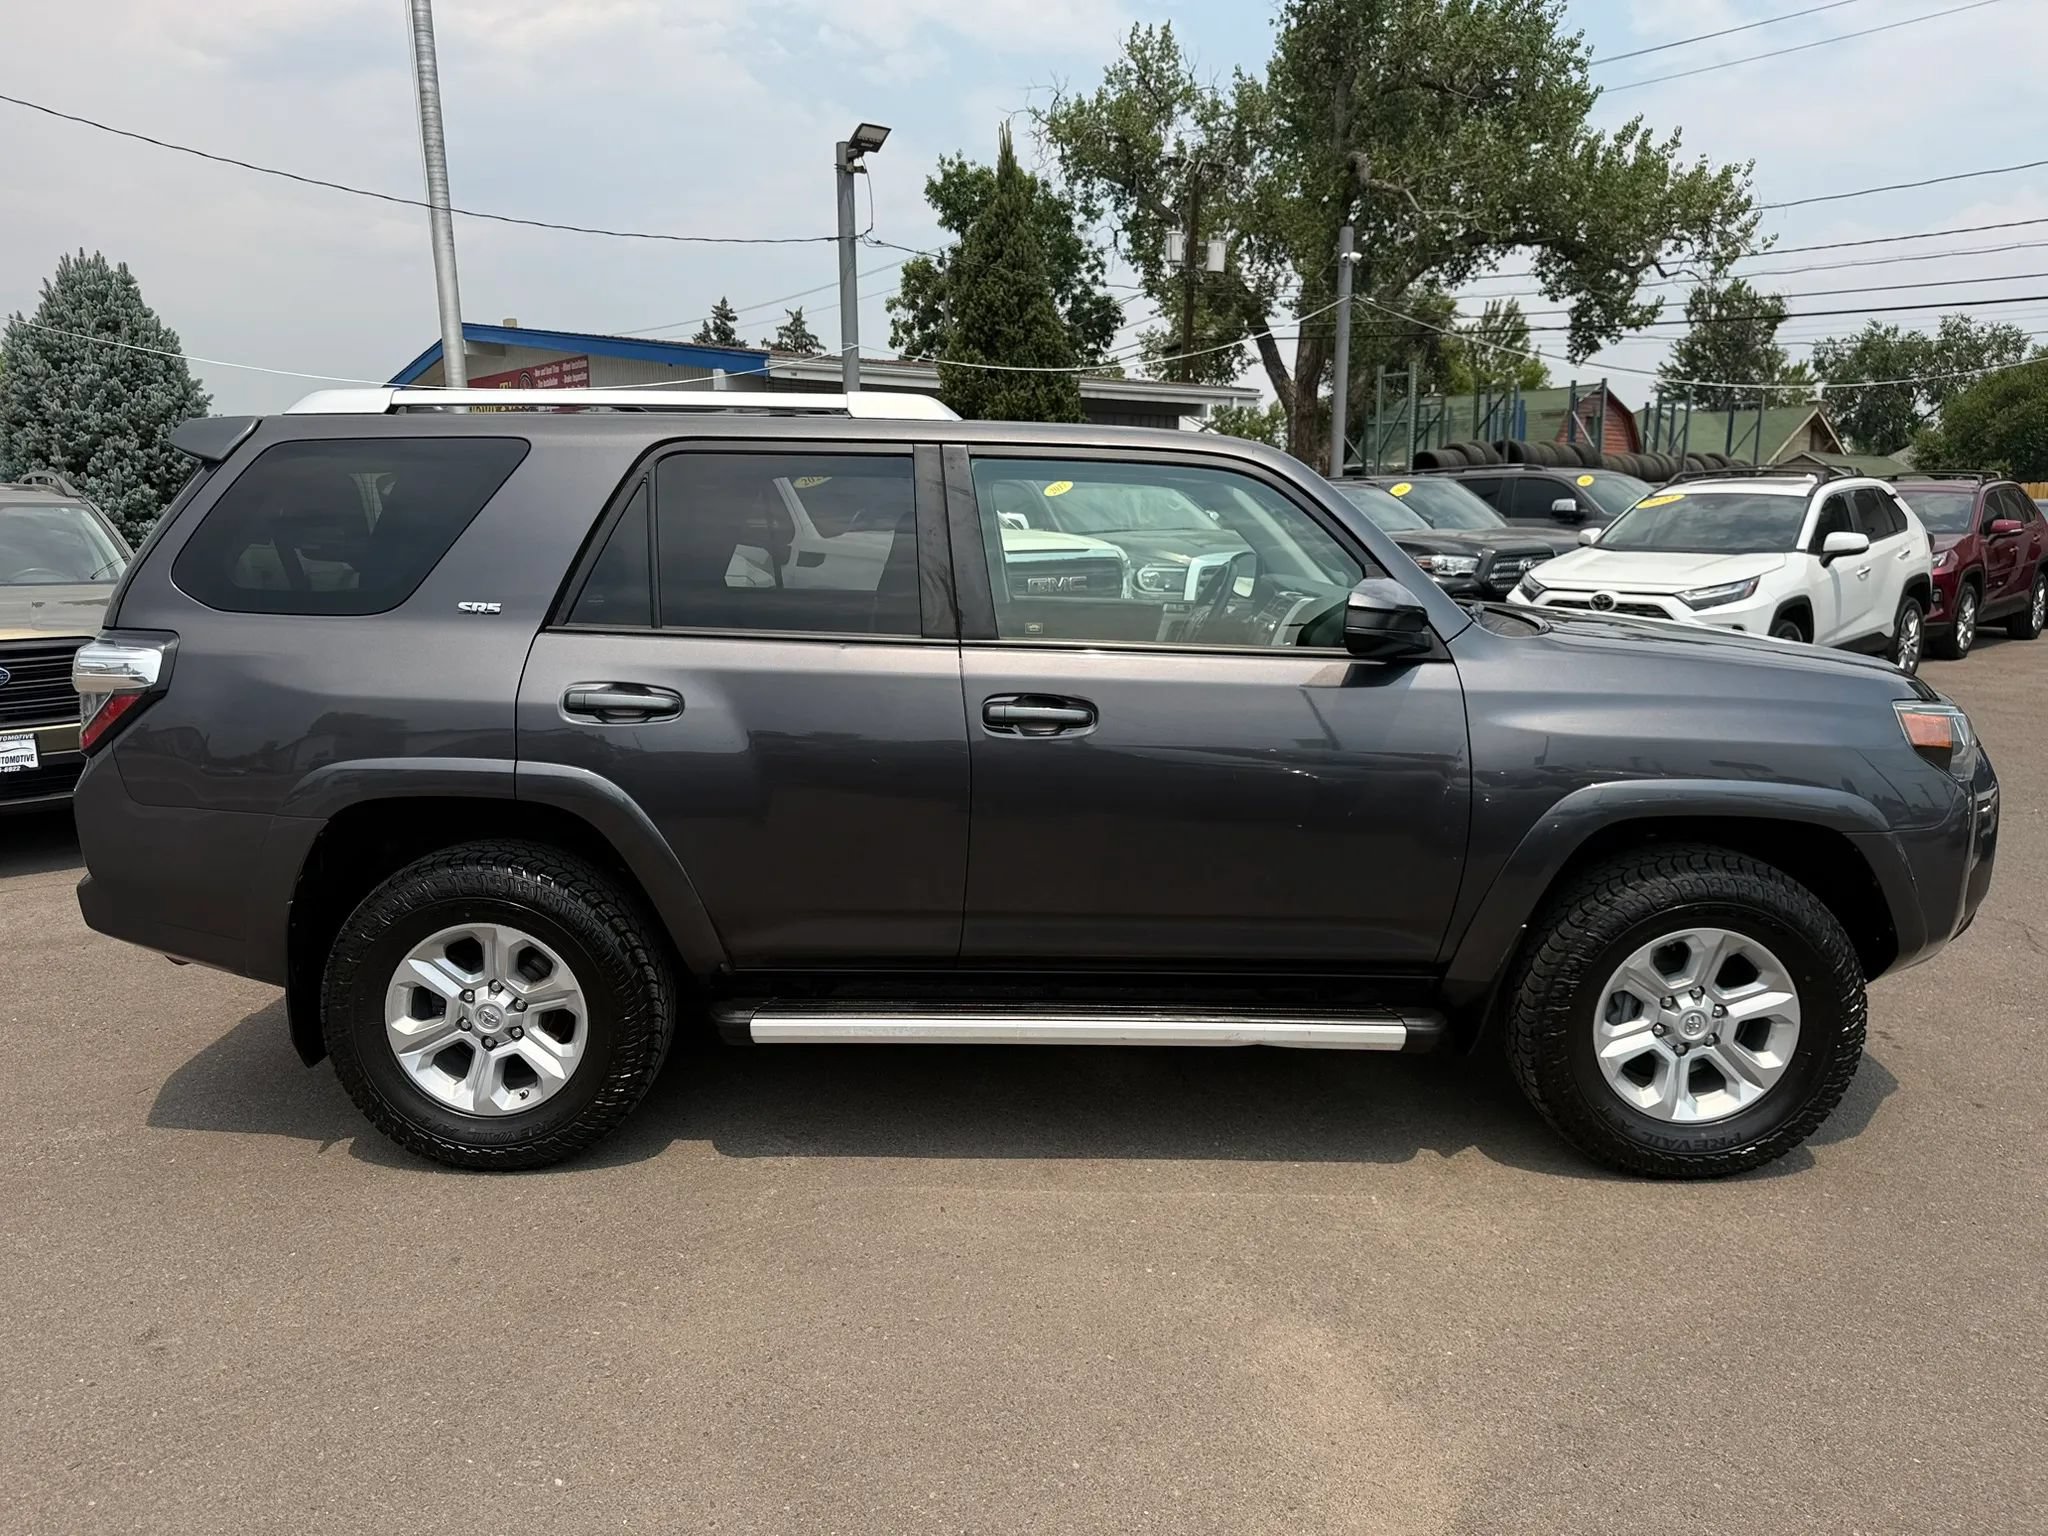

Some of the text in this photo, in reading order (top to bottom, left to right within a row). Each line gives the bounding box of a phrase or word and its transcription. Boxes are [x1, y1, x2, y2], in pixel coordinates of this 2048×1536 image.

[1027, 576, 1088, 593] GMC
[458, 601, 502, 612] SR5
[0, 754, 34, 764] TOMOTIVE
[1642, 1131, 1742, 1152] PREVAIL
